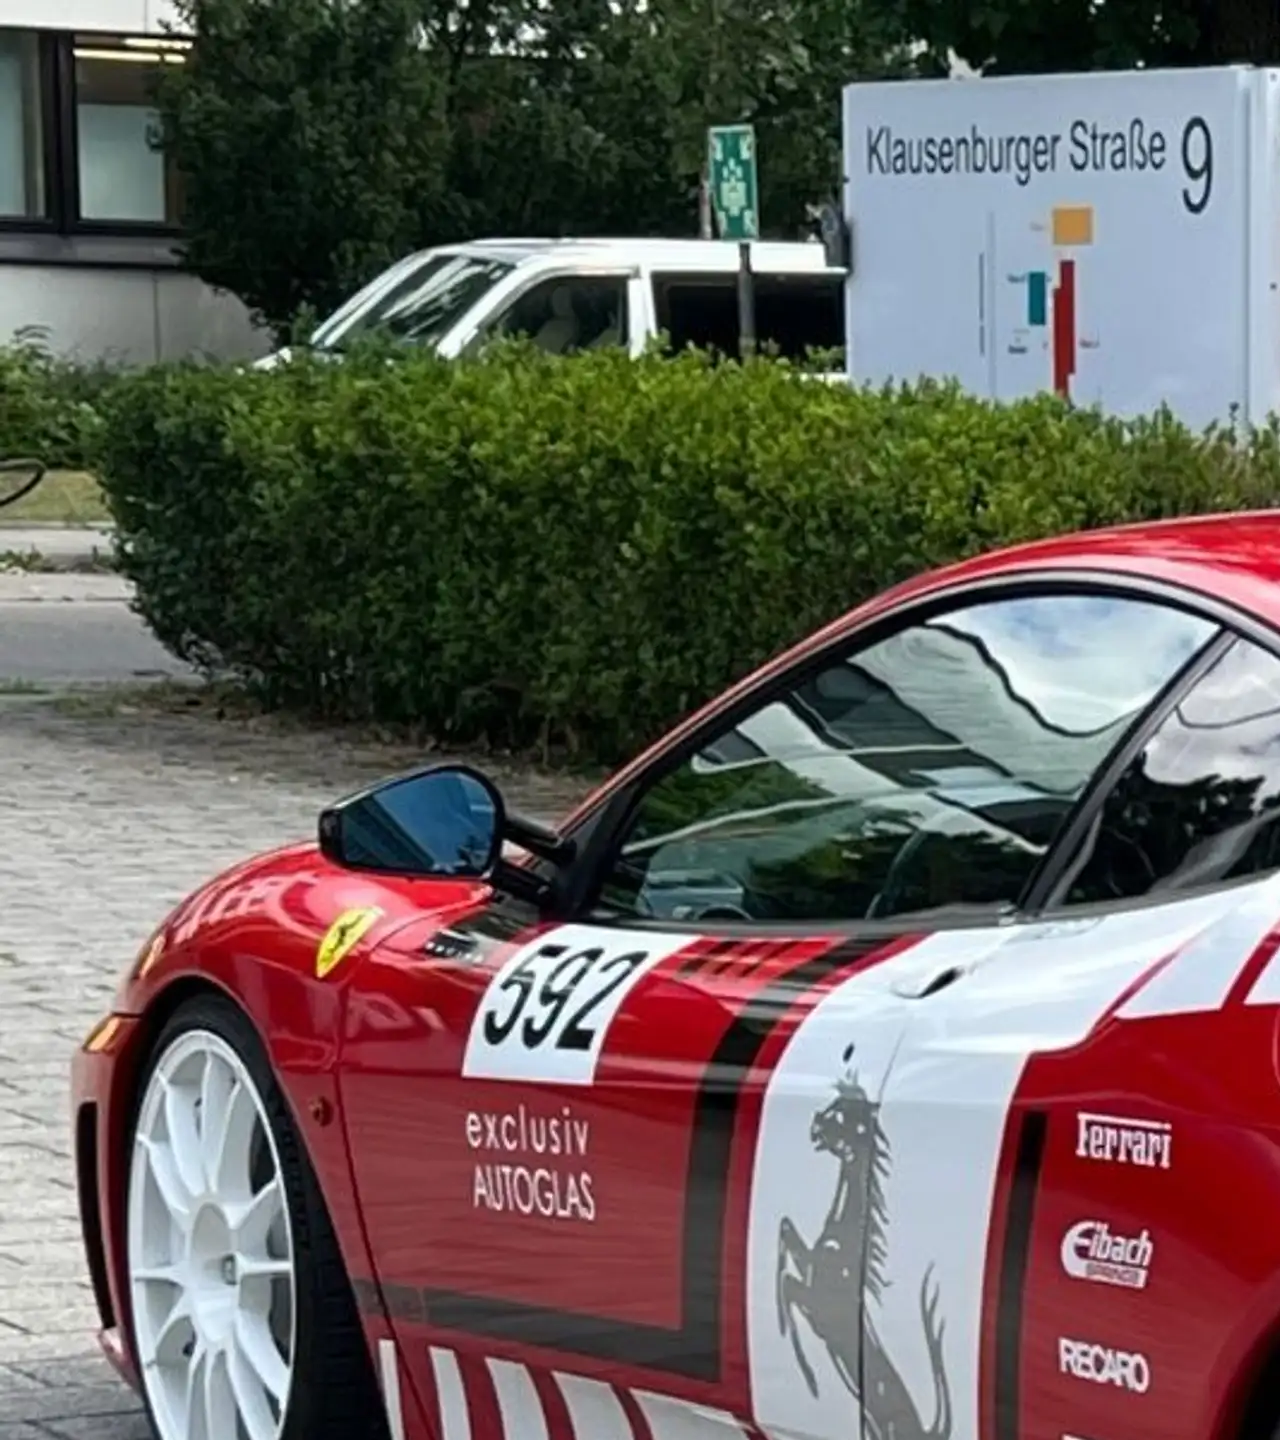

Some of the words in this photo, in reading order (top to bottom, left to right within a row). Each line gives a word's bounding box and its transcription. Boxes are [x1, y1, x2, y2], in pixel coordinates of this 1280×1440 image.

[866, 124, 1062, 187] Klausenburger
[1069, 117, 1167, 172] Straße
[1181, 115, 1214, 215] 9
[483, 944, 649, 1051] 592
[465, 1104, 590, 1156] exclusiv
[1075, 1112, 1173, 1169] Ferrari
[474, 1165, 596, 1221] AUTOGLAS
[1061, 1219, 1153, 1277] Eibach
[1058, 1336, 1150, 1394] RECARO
